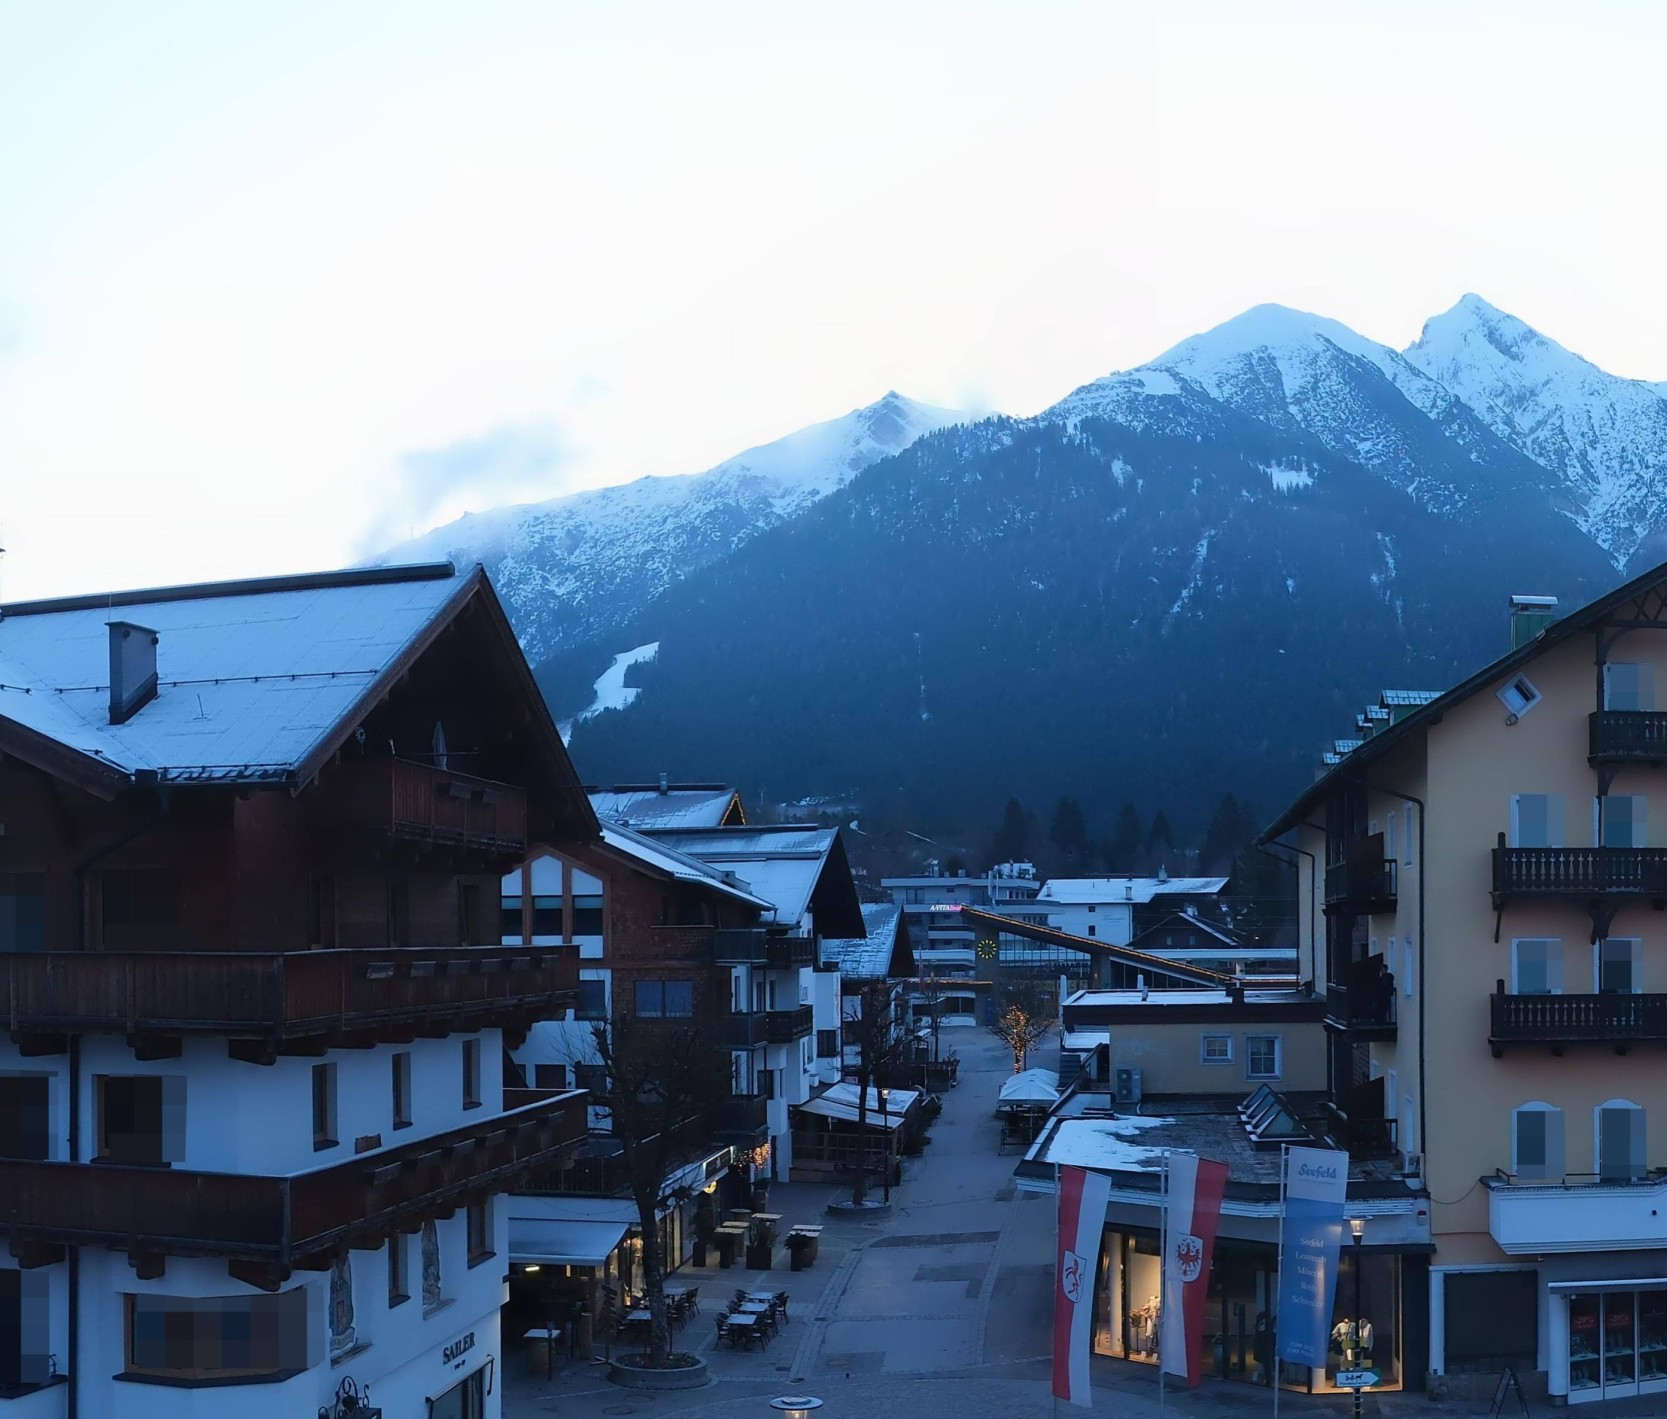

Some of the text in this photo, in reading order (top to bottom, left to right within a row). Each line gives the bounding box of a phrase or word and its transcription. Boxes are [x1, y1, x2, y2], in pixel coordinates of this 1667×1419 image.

[1298, 1163, 1337, 1179] Seefeld
[1300, 1237, 1324, 1248] Seefeld
[443, 1331, 475, 1366] SAILER
